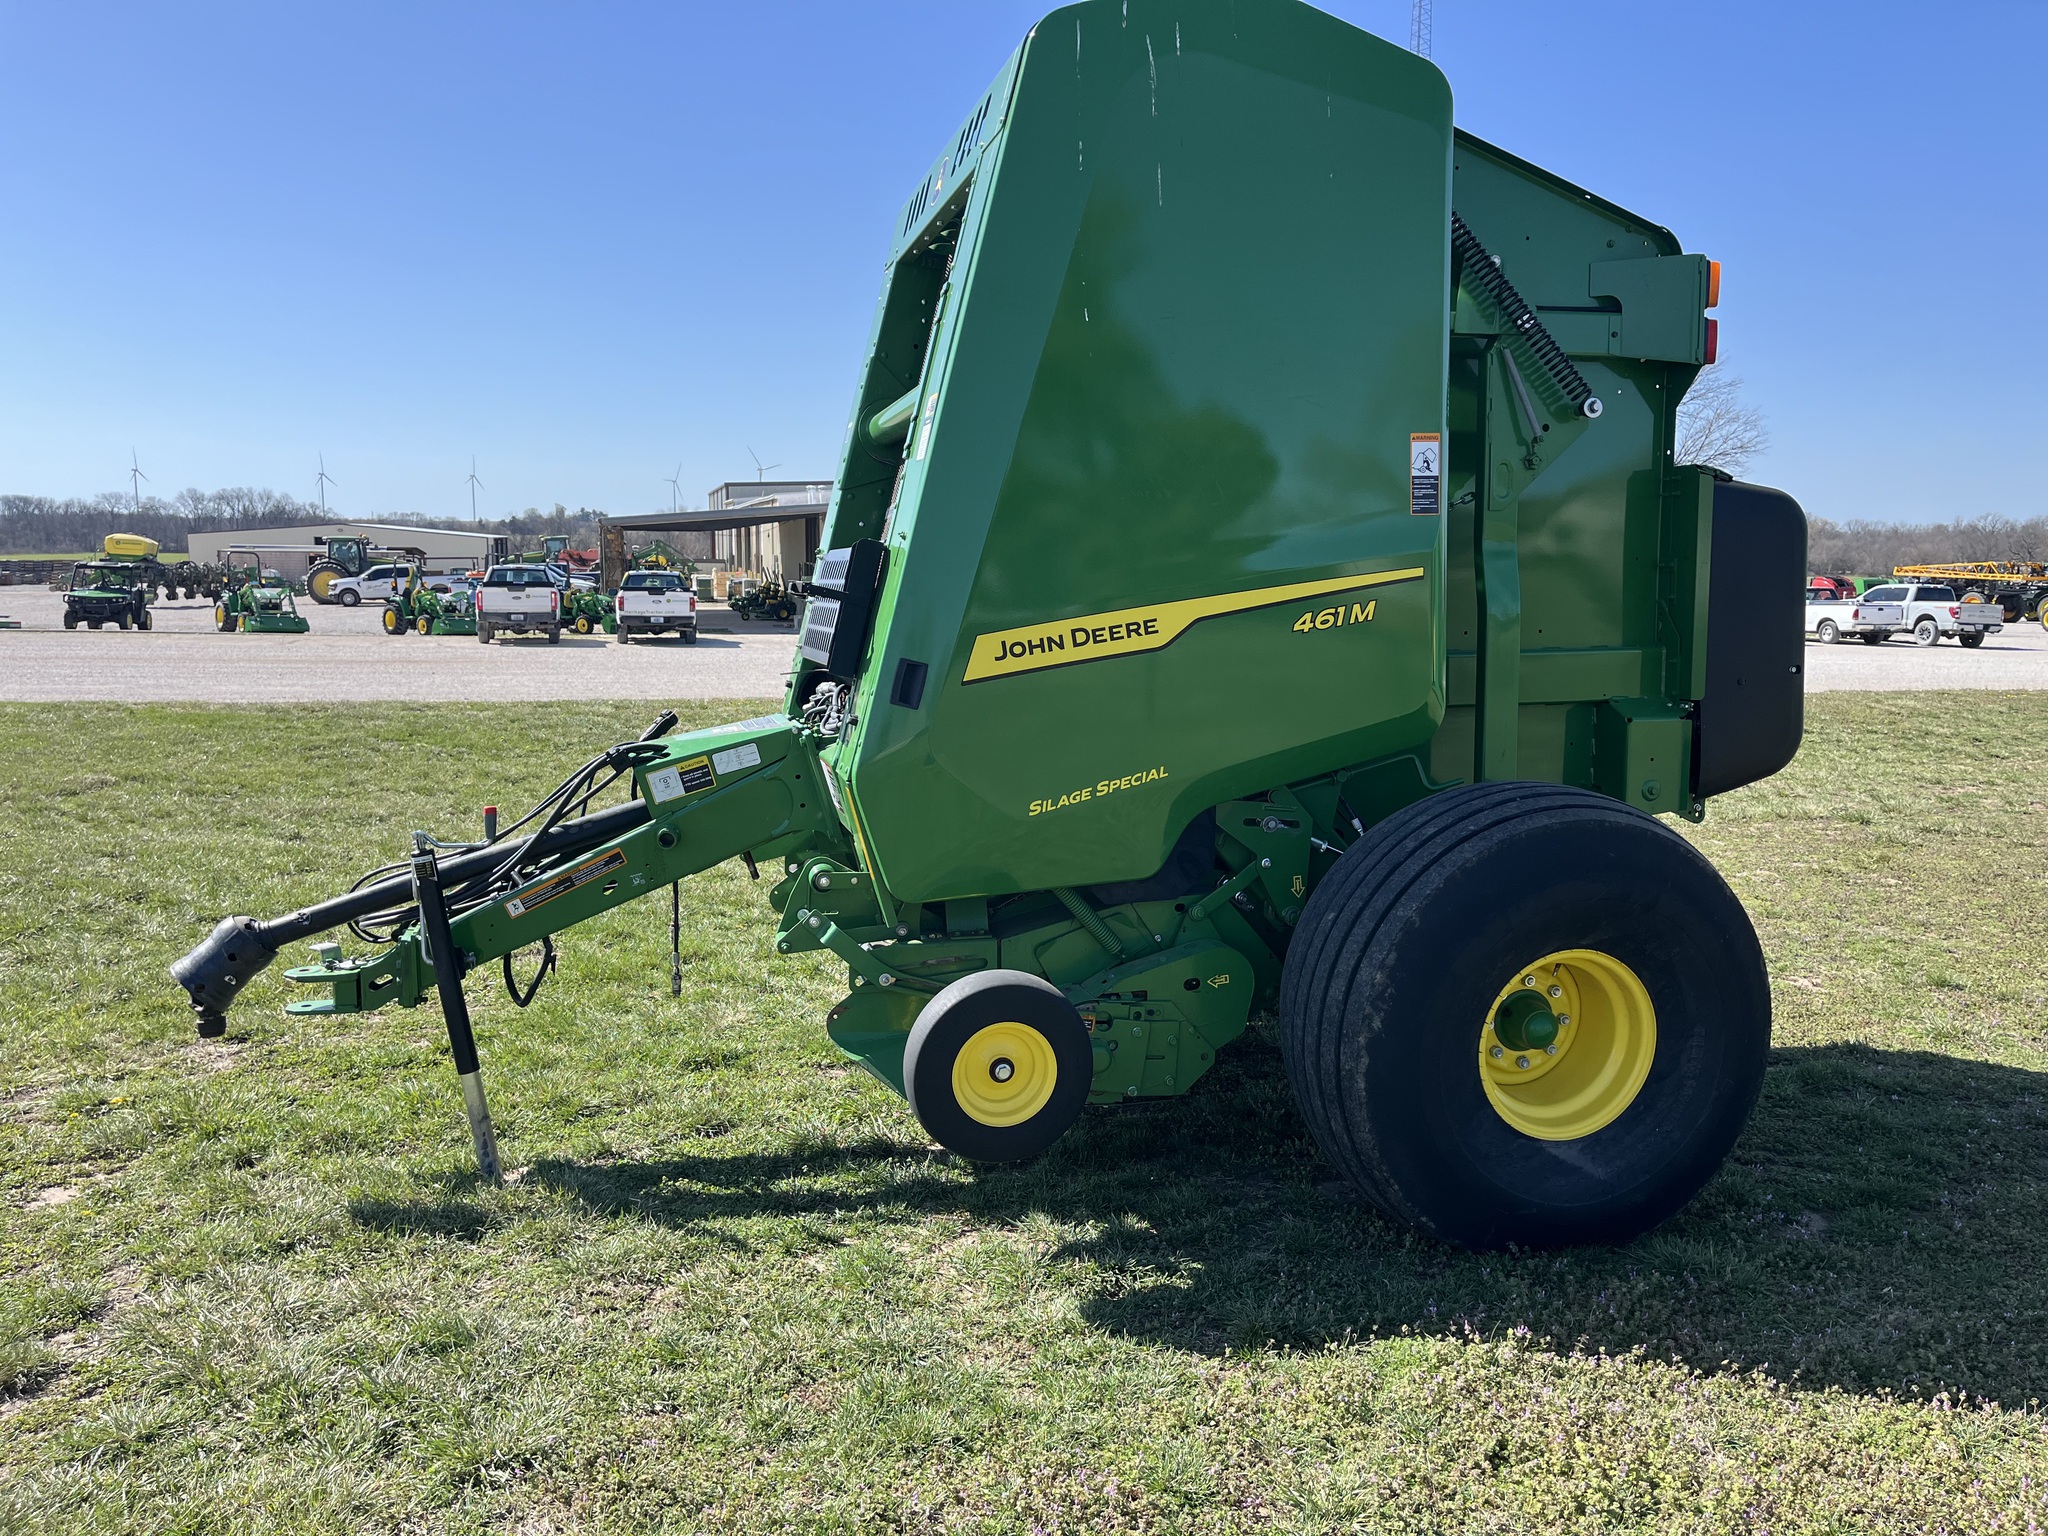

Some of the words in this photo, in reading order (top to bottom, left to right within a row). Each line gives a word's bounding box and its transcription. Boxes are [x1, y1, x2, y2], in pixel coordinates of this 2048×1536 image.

[1292, 599, 1378, 634] 461M
[994, 634, 1065, 662] JOHN
[1070, 618, 1159, 648] DEERE
[1028, 787, 1093, 817] SILAGE
[1095, 766, 1169, 797] SPECIAL
